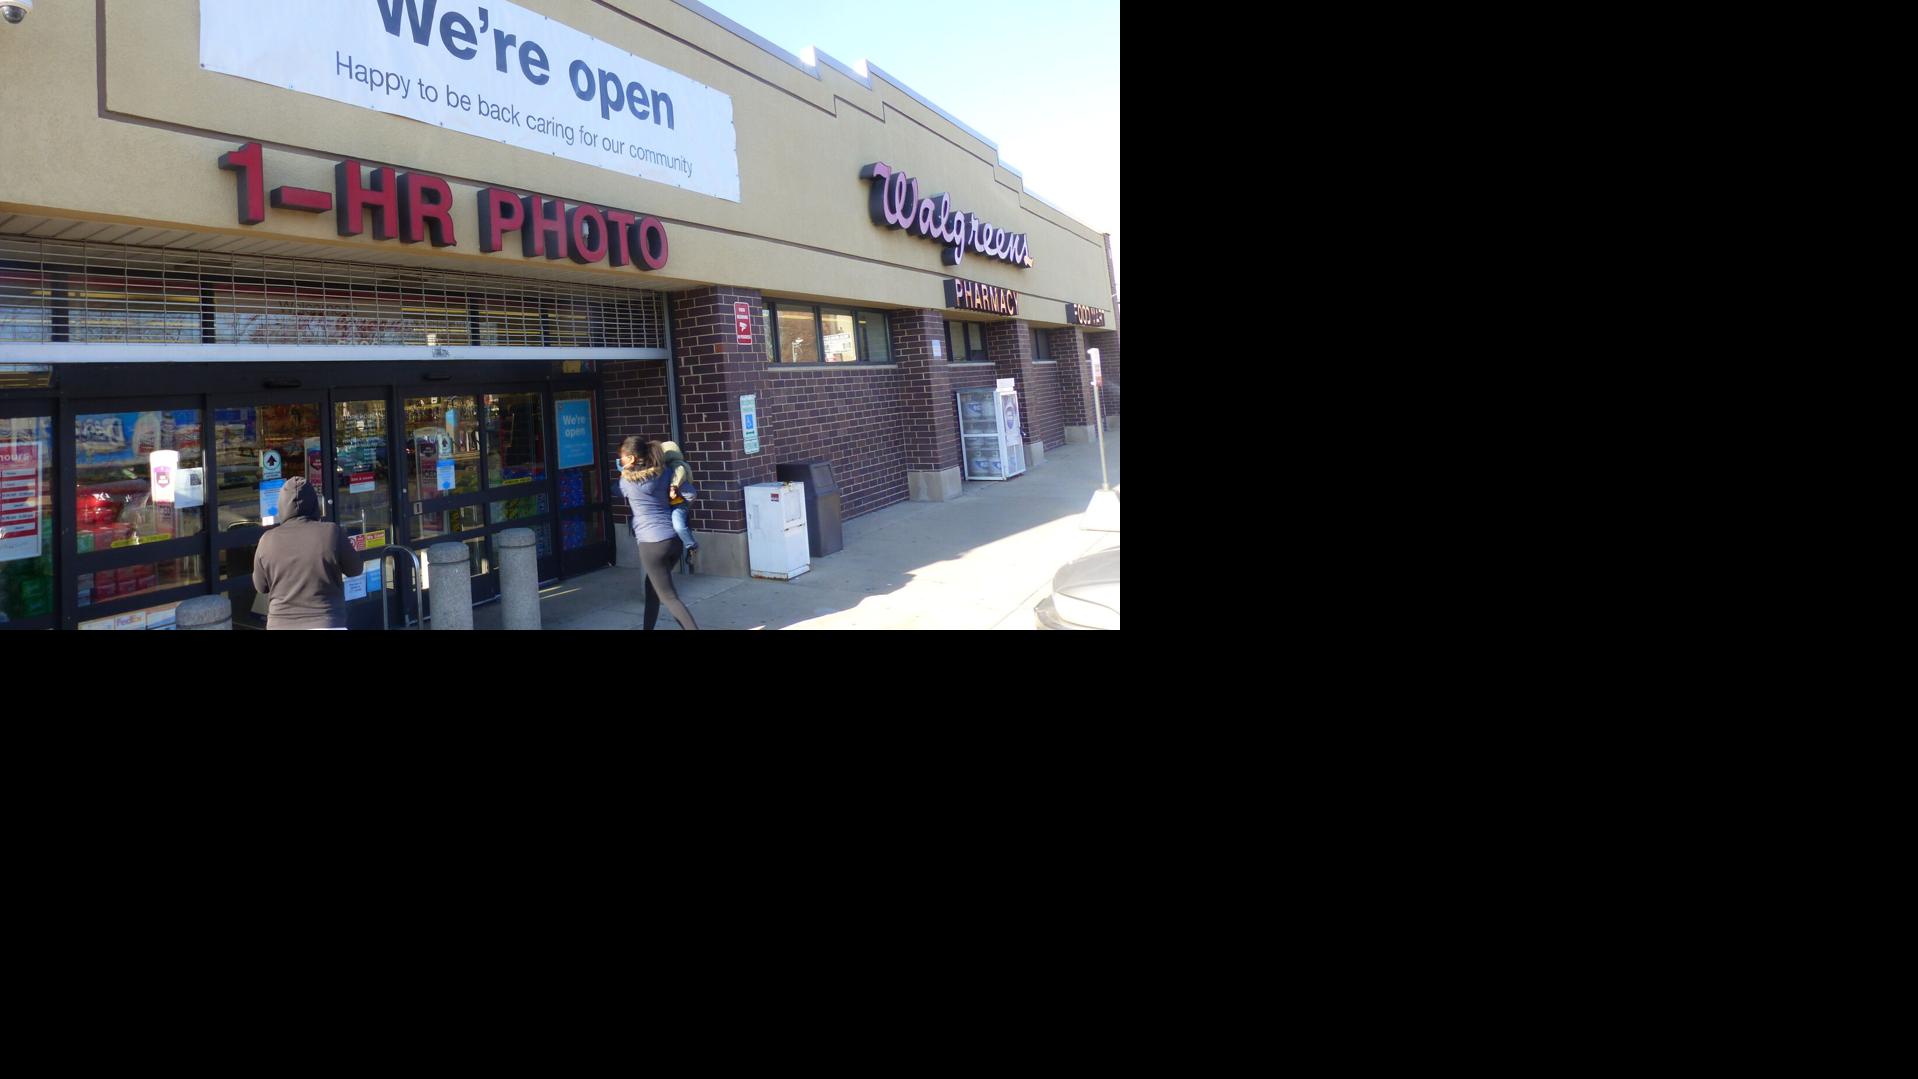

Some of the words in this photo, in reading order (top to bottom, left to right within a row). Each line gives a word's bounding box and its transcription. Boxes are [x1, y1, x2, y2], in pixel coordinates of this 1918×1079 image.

[377, 0, 550, 85] We're
[569, 59, 675, 130] open
[337, 51, 410, 99] Happy
[418, 78, 438, 102] to
[447, 84, 471, 111] be
[478, 94, 521, 127] back
[526, 115, 575, 146] caring
[579, 125, 598, 147] for
[602, 137, 625, 155] our
[630, 144, 693, 178] community
[477, 187, 669, 271] PHOTO
[860, 161, 1033, 268] Walgreens
[954, 278, 1020, 316] PHARMACY
[563, 414, 586, 425] We're
